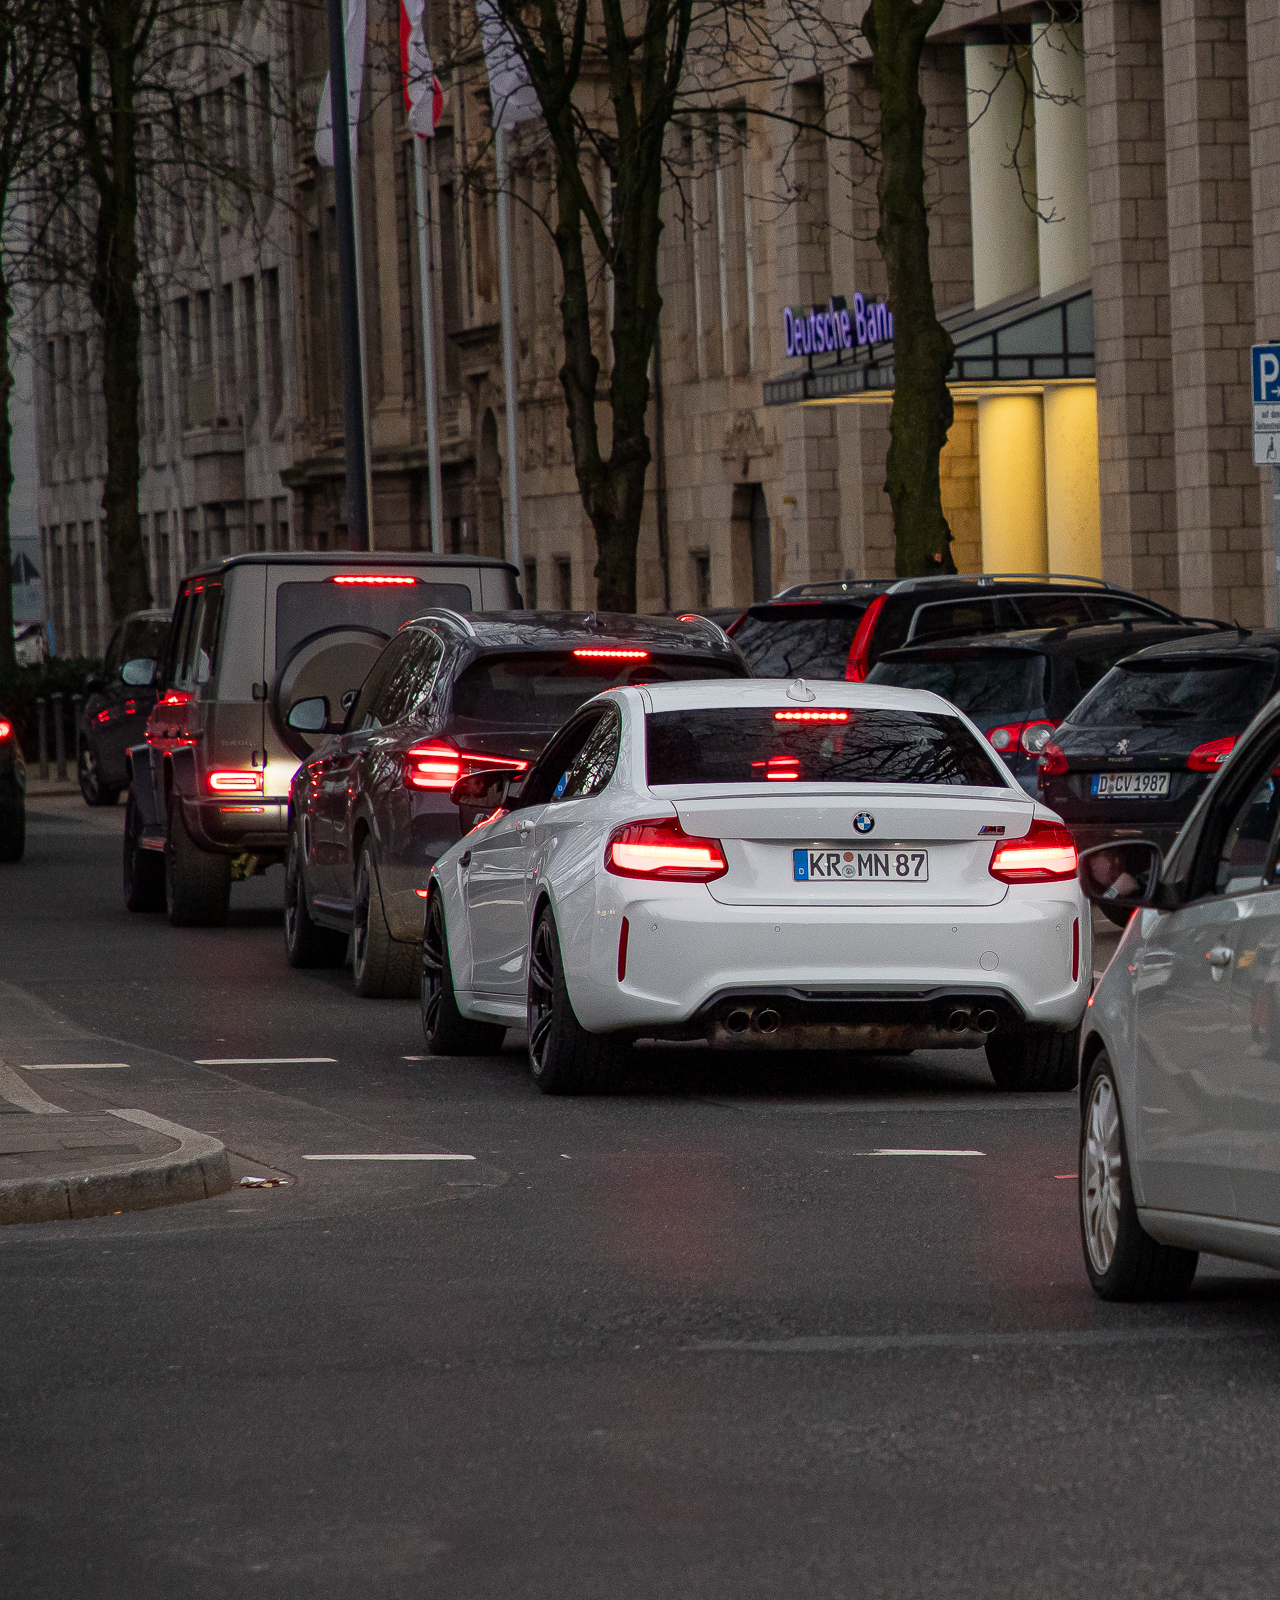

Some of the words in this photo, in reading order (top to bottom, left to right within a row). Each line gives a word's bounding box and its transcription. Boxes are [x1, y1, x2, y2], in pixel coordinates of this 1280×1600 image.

[783, 299, 852, 356] Deutsche
[1260, 353, 1280, 400] P
[1100, 776, 1108, 792] D
[1115, 775, 1132, 792] CV
[1134, 775, 1167, 792] 1987
[810, 853, 841, 877] KR
[857, 853, 889, 877] MN
[896, 853, 925, 877] 87
